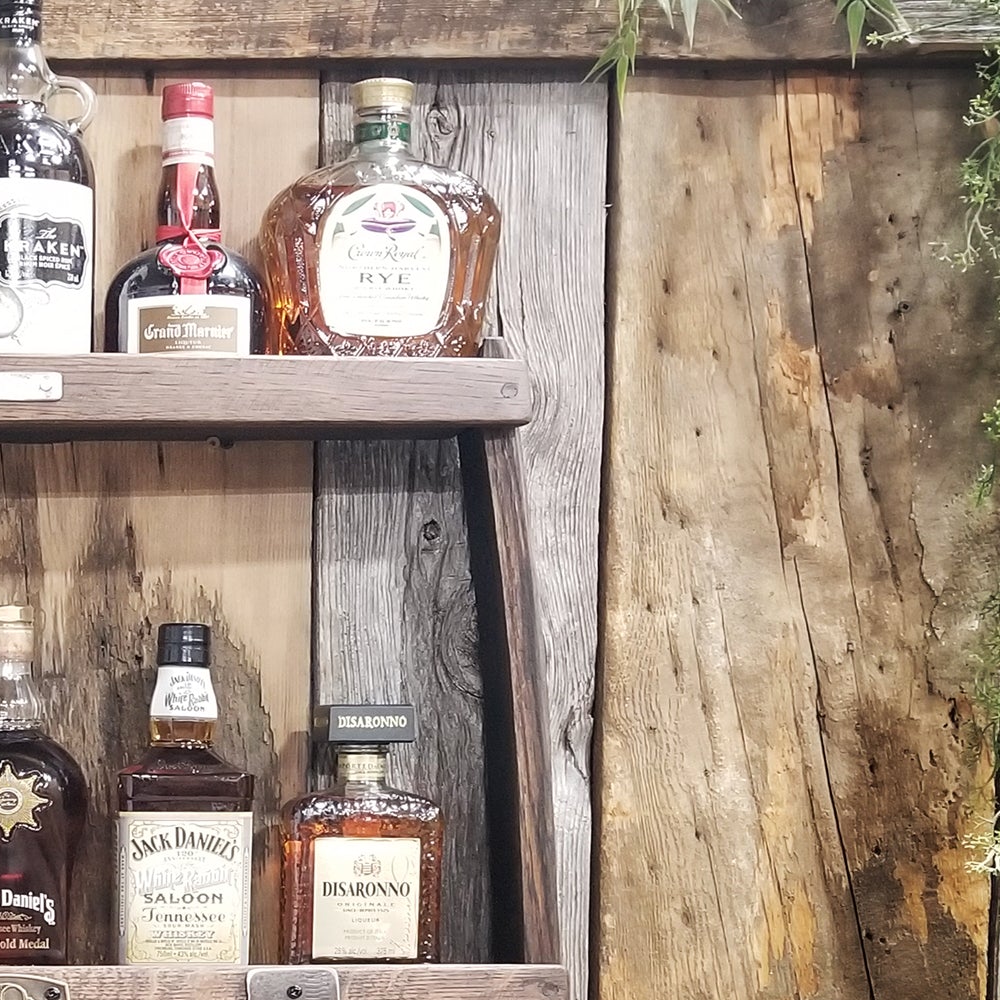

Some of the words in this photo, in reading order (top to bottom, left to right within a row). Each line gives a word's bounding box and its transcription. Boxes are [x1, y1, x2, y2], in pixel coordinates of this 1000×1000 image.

[3, 239, 81, 258] KRAKEN
[347, 243, 383, 261] Crown
[383, 242, 420, 263] Royal
[360, 272, 412, 284] RYE
[143, 323, 182, 341] Grand
[182, 322, 235, 339] Marnier
[168, 704, 205, 712] SALOON
[337, 715, 408, 729] DISARONNO
[131, 832, 174, 862] JACK
[174, 826, 240, 862] DANIEL'S
[321, 881, 411, 899] DISARONNO
[143, 893, 224, 904] SALOON
[1, 889, 56, 926] Daniel's
[141, 907, 226, 922] Tennessee
[11, 923, 42, 935] Whiskey
[152, 930, 216, 939] WHISKEY
[18, 938, 50, 950] Medal
